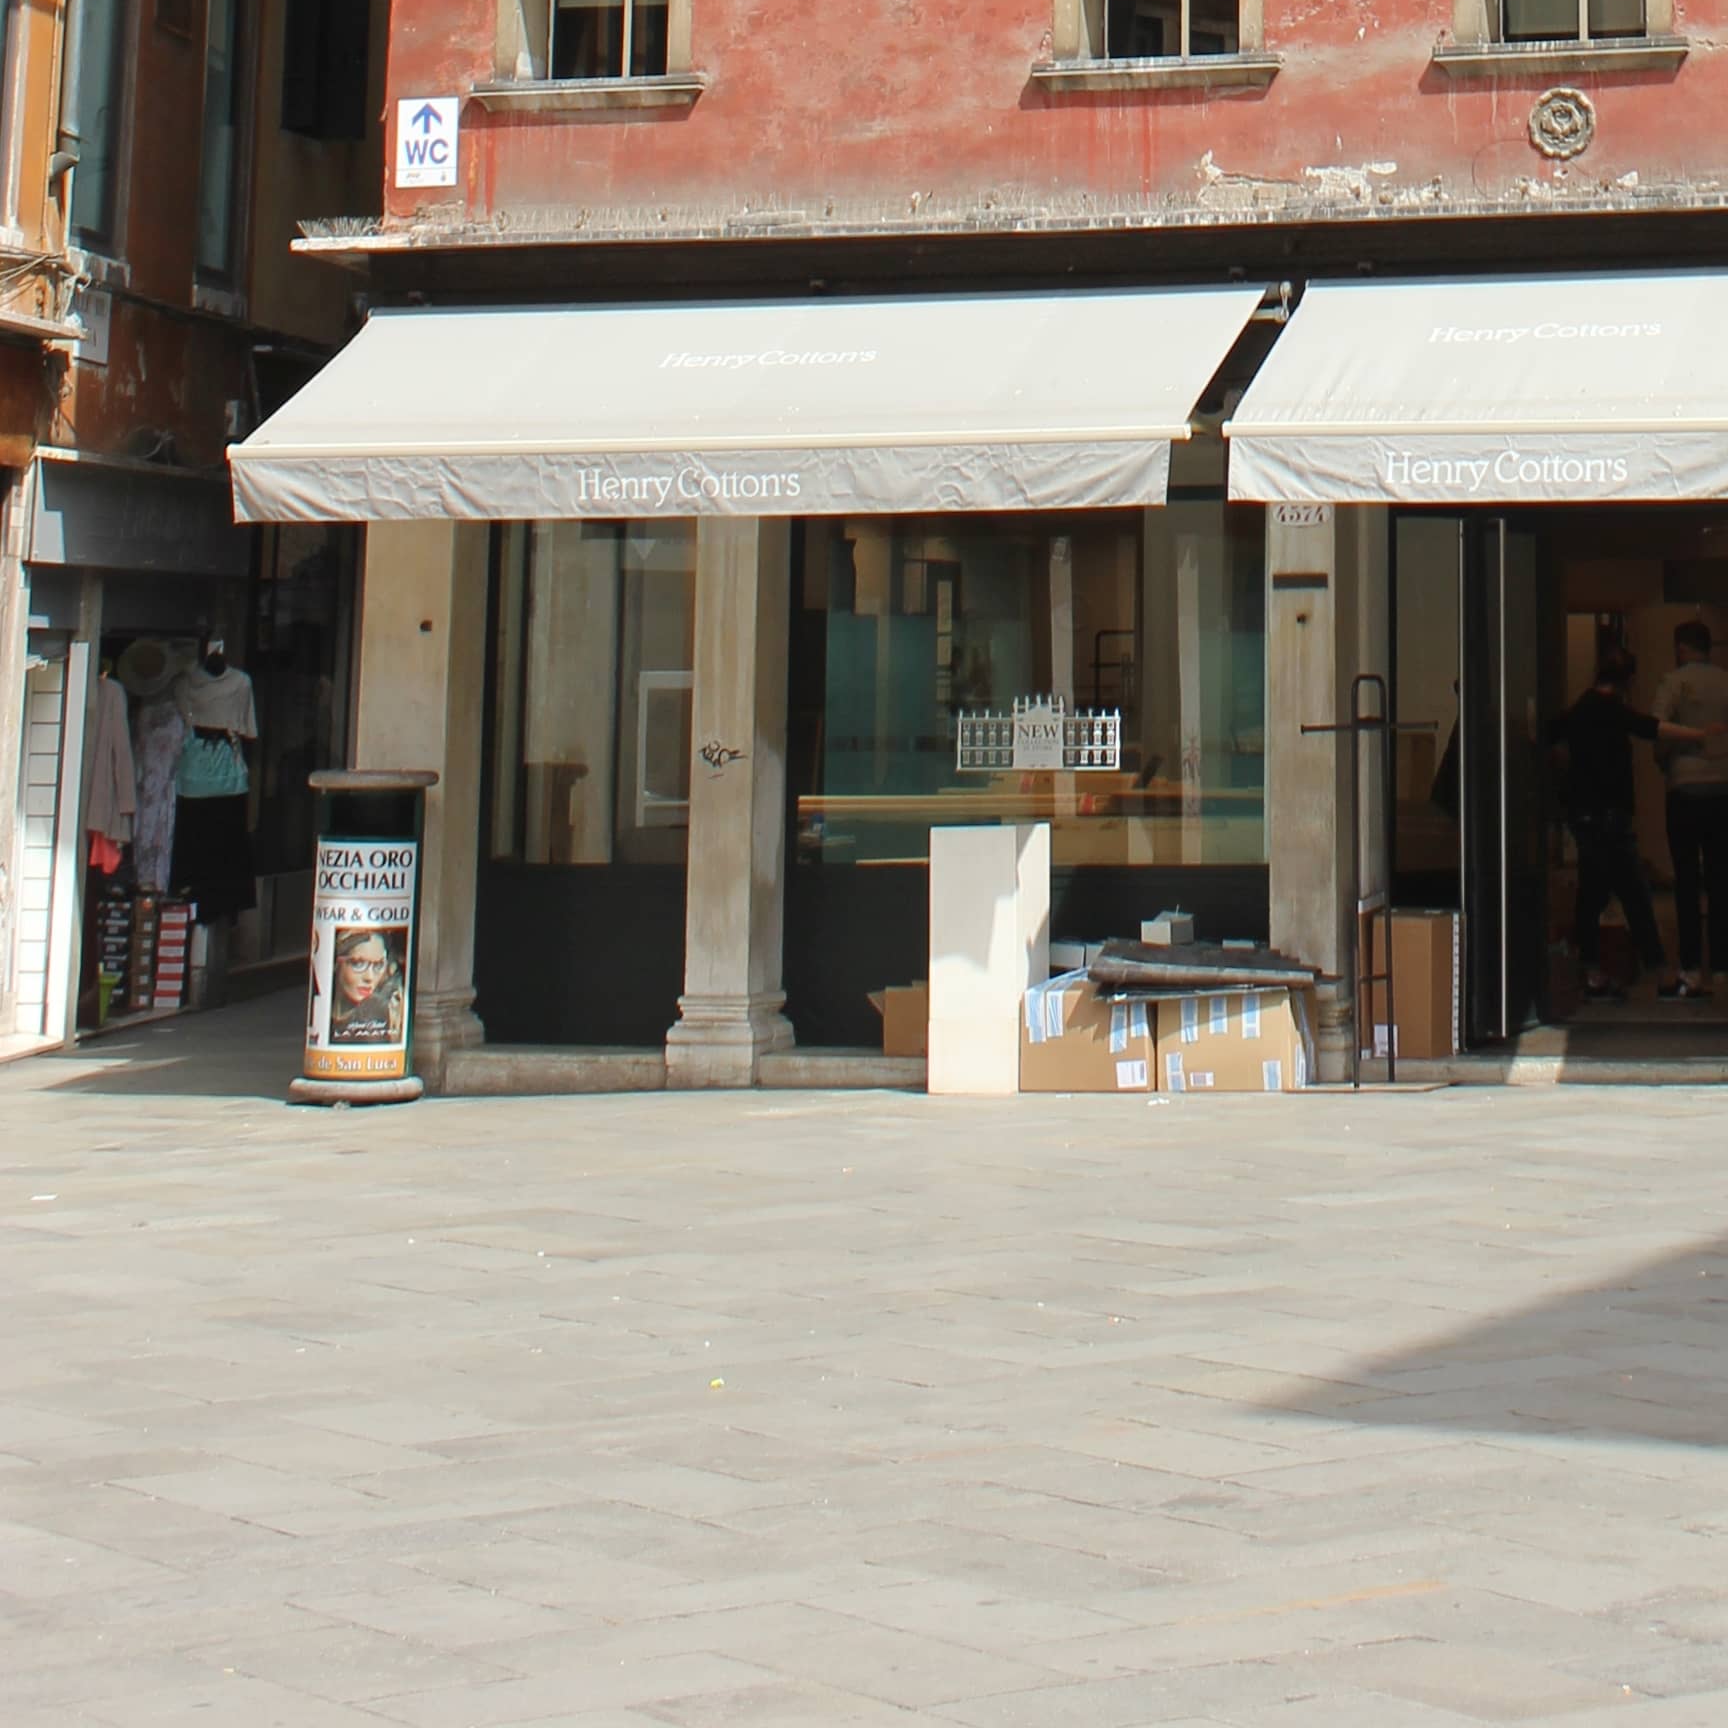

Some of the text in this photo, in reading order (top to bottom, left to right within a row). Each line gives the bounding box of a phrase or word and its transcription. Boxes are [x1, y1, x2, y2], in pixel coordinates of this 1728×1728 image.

[404, 138, 449, 166] WC
[1427, 322, 1662, 345] Henry Cotton's
[657, 349, 879, 370] Henry Cotton's
[1383, 450, 1629, 492] Henry Cotton's
[577, 466, 801, 508] Henry Cotton's
[1276, 504, 1323, 523] 4574
[1017, 724, 1060, 738] NEW
[369, 849, 413, 869] ORO
[318, 870, 406, 890] OCCHIALI
[350, 906, 363, 922] &
[367, 906, 410, 922] GOLD
[336, 1055, 362, 1072] San
[366, 1055, 398, 1072] Luca
